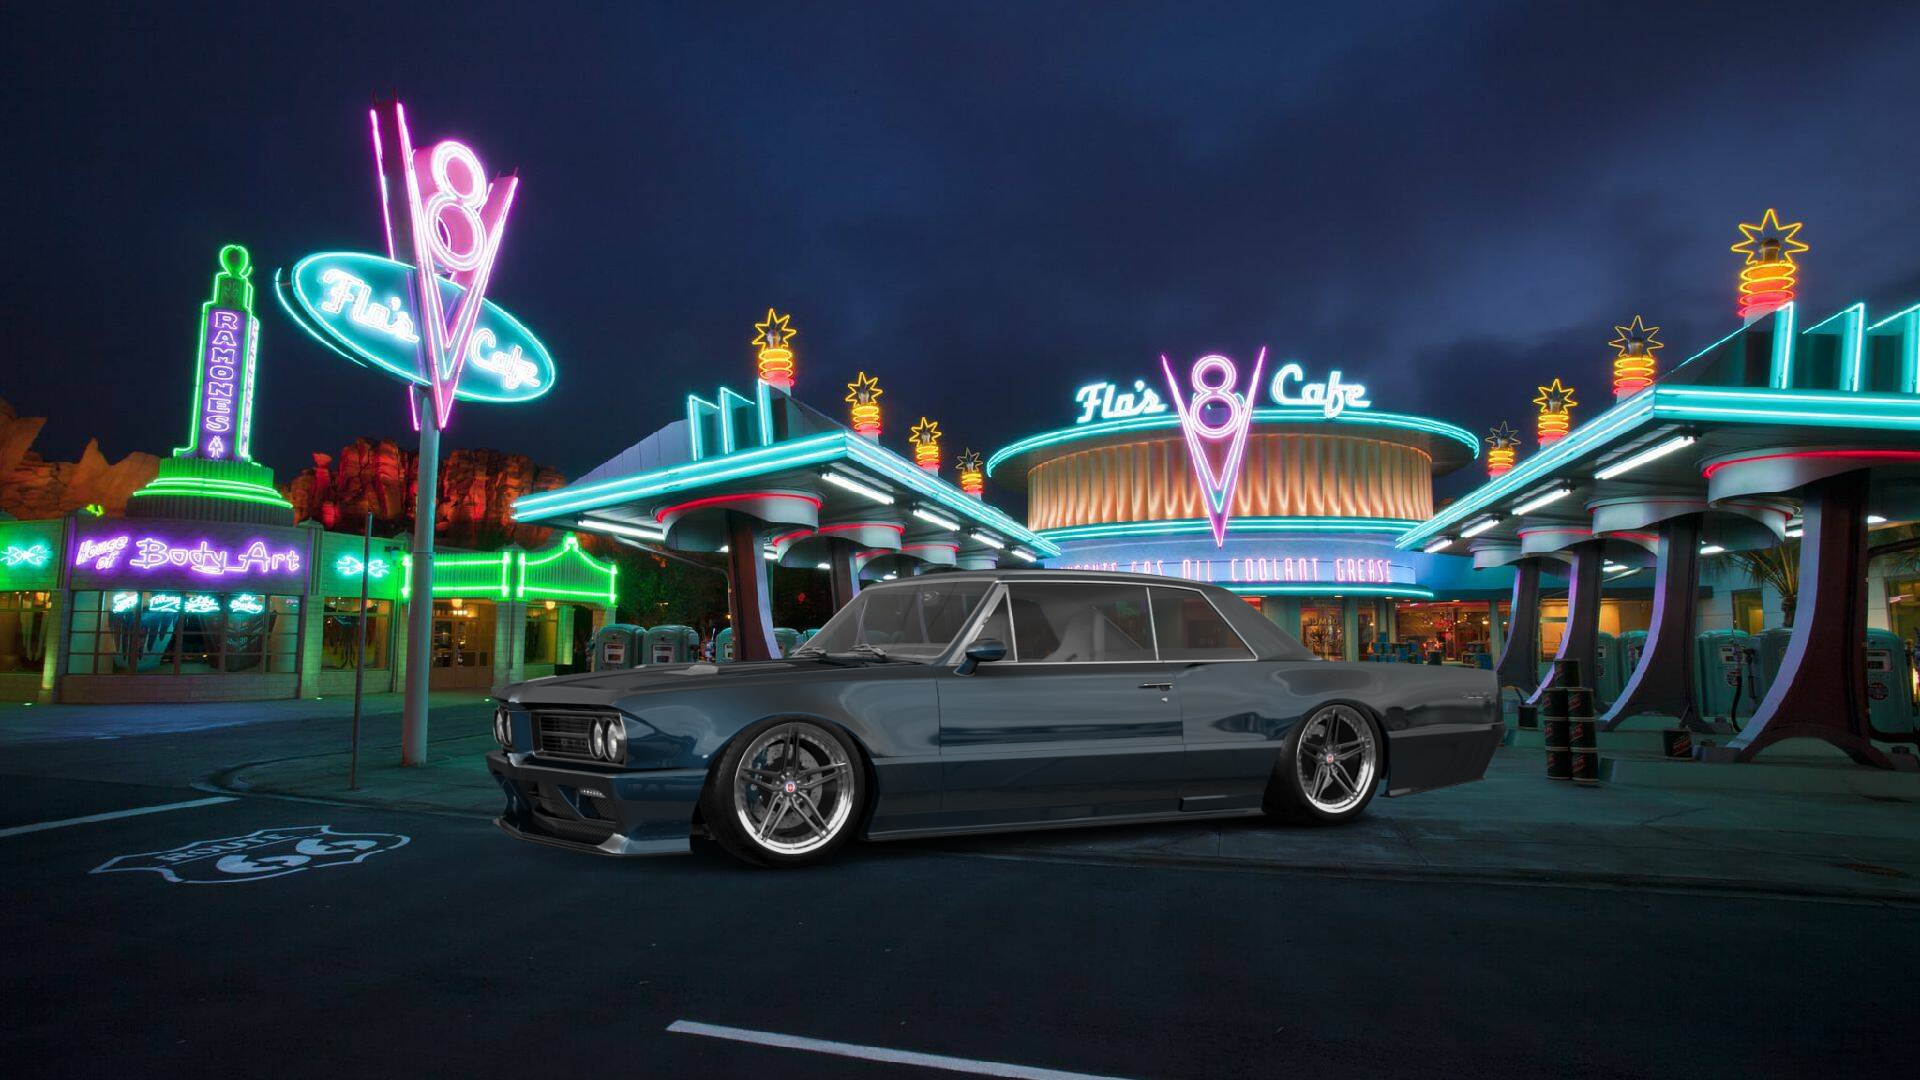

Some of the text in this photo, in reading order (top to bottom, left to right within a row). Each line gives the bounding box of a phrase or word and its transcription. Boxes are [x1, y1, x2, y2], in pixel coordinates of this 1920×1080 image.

[322, 267, 420, 343] Flo's
[469, 328, 541, 389] Cafe
[205, 311, 239, 433] RAMONES
[1076, 380, 1167, 423] Flo's
[1271, 364, 1371, 418] Cafe
[76, 536, 129, 565] House
[95, 550, 119, 570] of
[130, 538, 300, 575] Body Art
[1182, 559, 1213, 582] OIL
[1230, 558, 1319, 581] COOLANT
[1334, 558, 1392, 582] GREASE
[560, 738, 588, 748] GTO
[154, 833, 290, 862] ROUTE
[215, 837, 378, 874] 66
